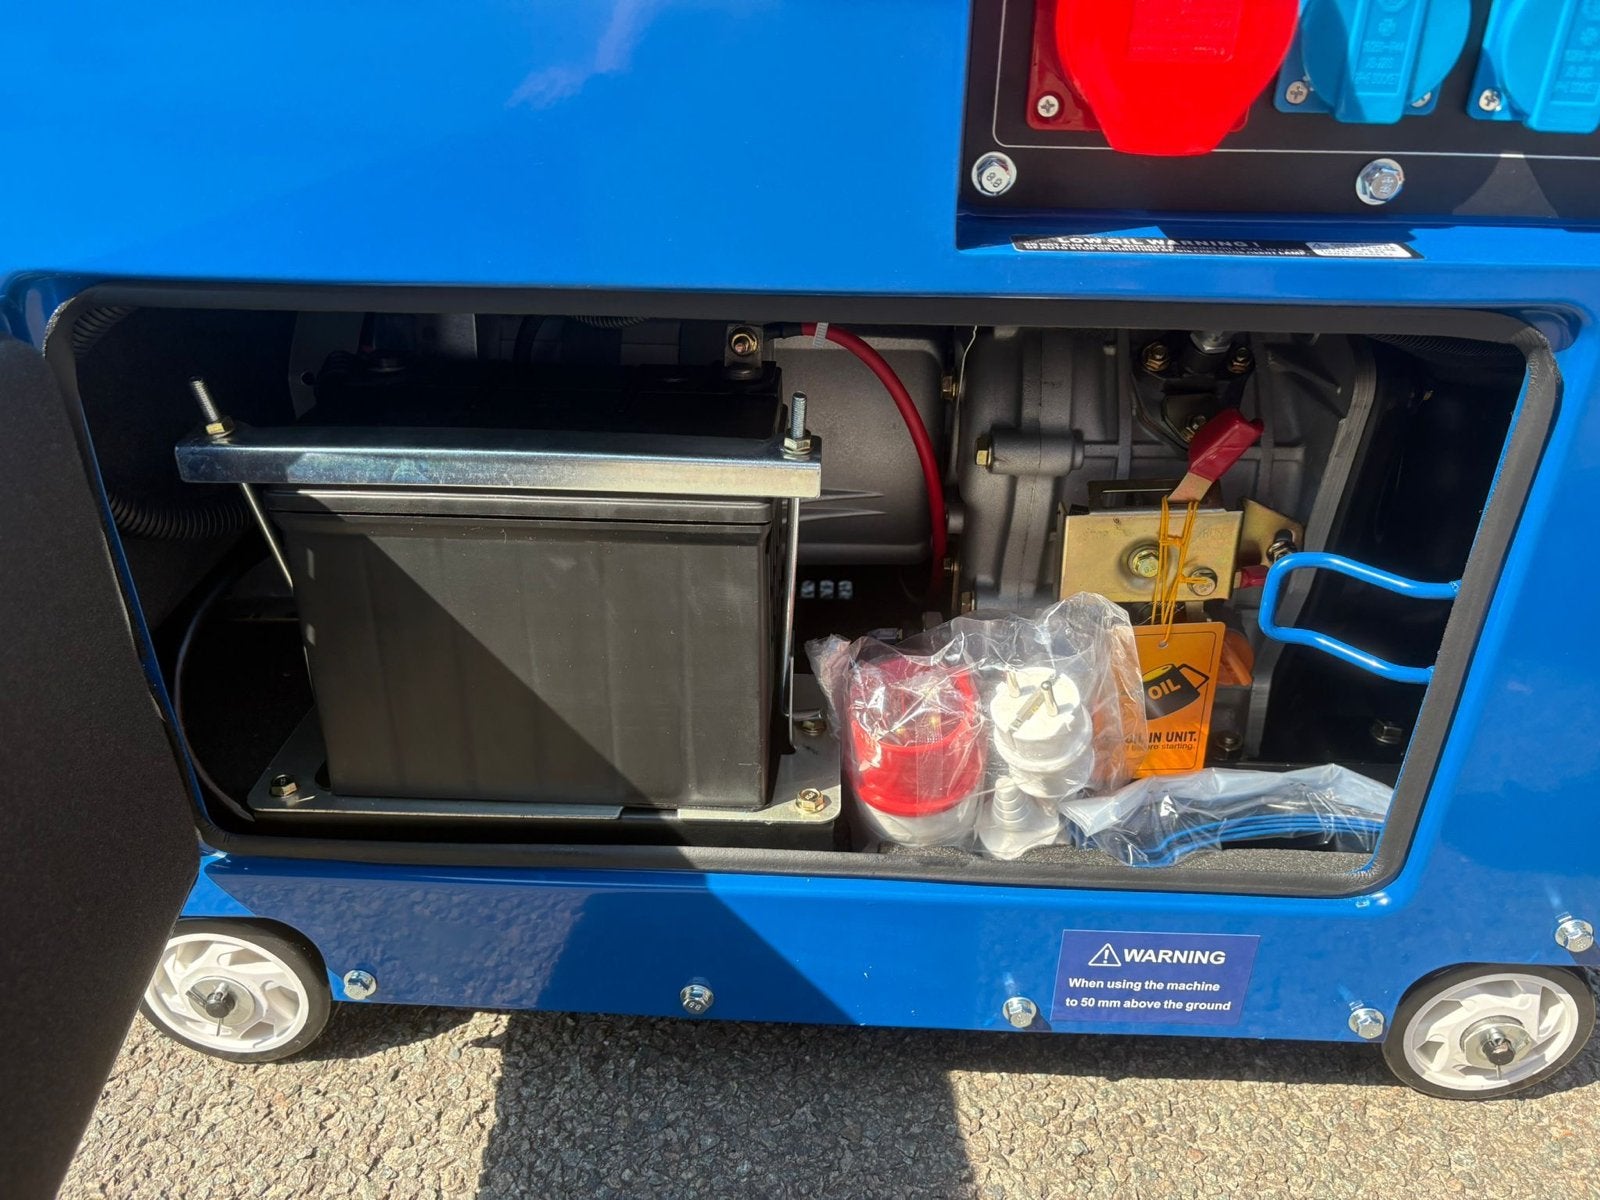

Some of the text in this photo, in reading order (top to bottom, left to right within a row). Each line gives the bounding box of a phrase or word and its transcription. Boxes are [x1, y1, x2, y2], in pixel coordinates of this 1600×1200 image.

[1146, 239, 1248, 247] WARNING
[1148, 679, 1181, 700] OIL
[1148, 732, 1162, 743] IN
[1165, 731, 1197, 742] UNIT.
[1161, 742, 1195, 751] starting.
[1123, 949, 1226, 964] WARNING
[1068, 978, 1220, 991] When using the machine
[1065, 997, 1231, 1012] to 50 mm above the ground
